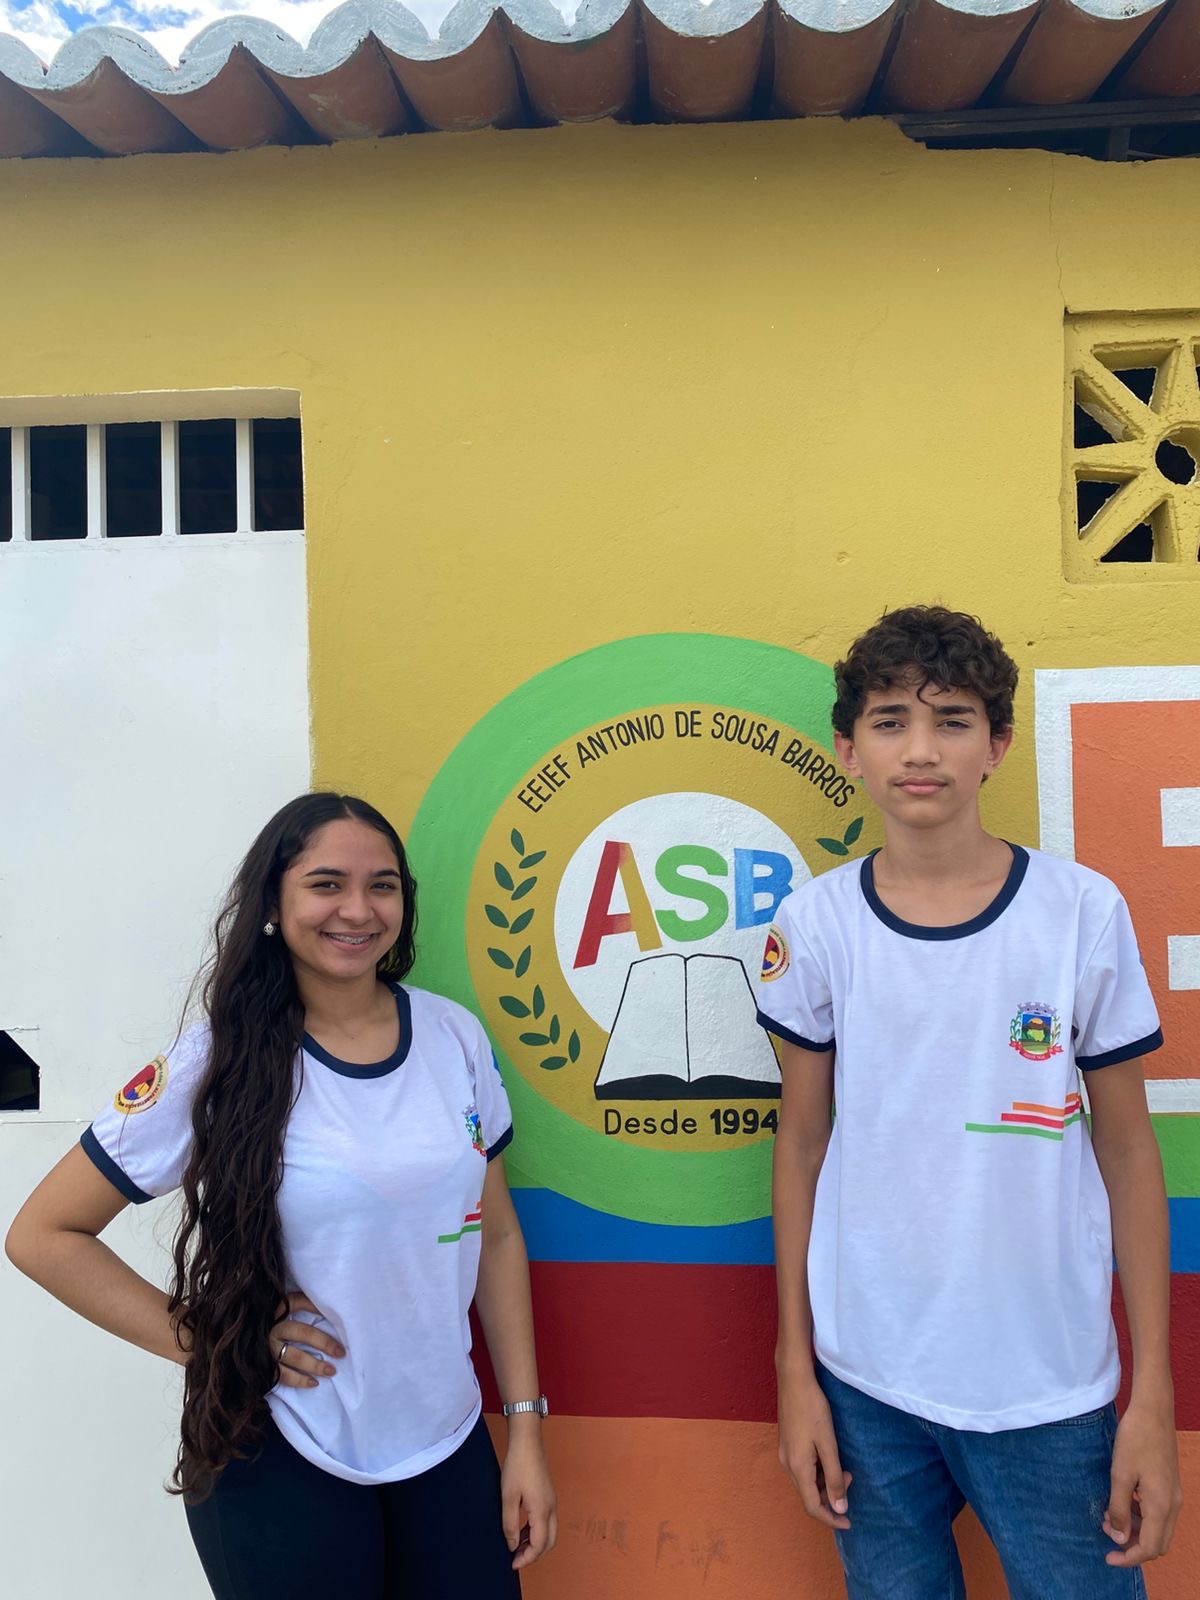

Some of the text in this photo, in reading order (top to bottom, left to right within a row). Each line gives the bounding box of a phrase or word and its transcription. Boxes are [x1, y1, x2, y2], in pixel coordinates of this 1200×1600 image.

[517, 710, 856, 813] EEIEF ANTONIO DE SOUSA BARROS
[573, 840, 794, 970] ASB
[604, 1108, 778, 1136] Desde 1994
